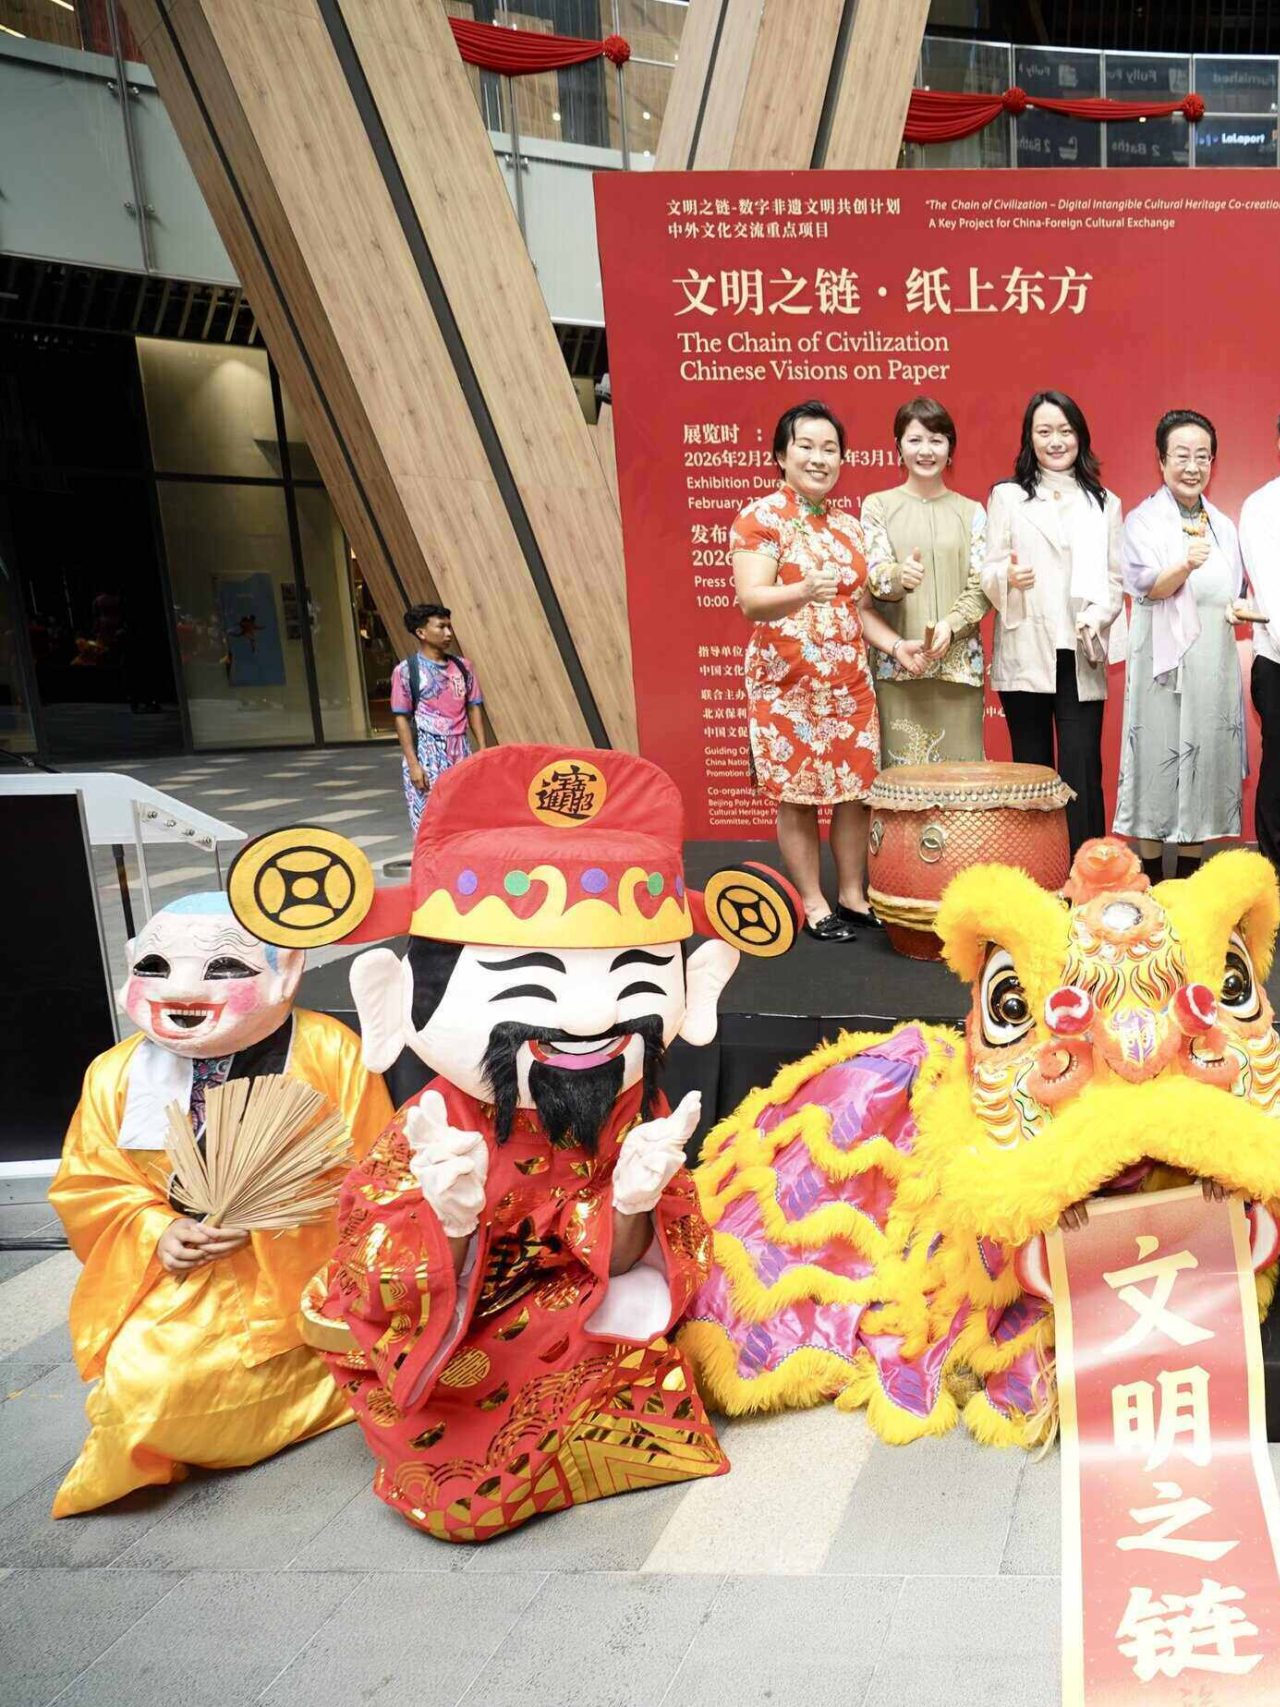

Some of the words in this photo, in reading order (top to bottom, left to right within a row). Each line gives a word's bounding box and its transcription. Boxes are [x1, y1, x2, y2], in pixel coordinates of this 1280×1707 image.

[952, 199, 980, 210] Chain
[982, 199, 993, 210] of
[993, 199, 1048, 210] Civilization
[1058, 199, 1091, 212] Digital
[1093, 199, 1142, 212] Intangible
[1145, 199, 1183, 210] Cultural
[1185, 199, 1226, 212] Heritage
[668, 221, 829, 239] 中外文化交流重点项目
[929, 218, 936, 228] A
[938, 218, 956, 230] Key
[959, 218, 994, 230] Project
[996, 217, 1011, 228] for
[1013, 217, 1083, 230] China-Foreign
[1085, 217, 1125, 228] Cultural
[1127, 218, 1175, 230] Exchange
[678, 332, 721, 353] The
[727, 331, 793, 353] Chain
[798, 331, 823, 353] of
[826, 331, 950, 353] Civilization
[680, 360, 766, 381] Chinese
[770, 360, 848, 381] Visions
[853, 366, 883, 381] on
[887, 360, 950, 385] Paper
[687, 476, 750, 489] Exhibition
[688, 497, 743, 512] February
[694, 575, 727, 588] Press
[696, 595, 730, 608] 10:00
[704, 746, 738, 757] Guiding
[705, 758, 727, 766] China
[706, 769, 744, 777] Promotion
[708, 799, 733, 808] Beijing
[708, 808, 737, 816] Cultural
[738, 808, 769, 817] Heritage
[752, 817, 773, 825] China
[1102, 1236, 1265, 1683] 文明之链
